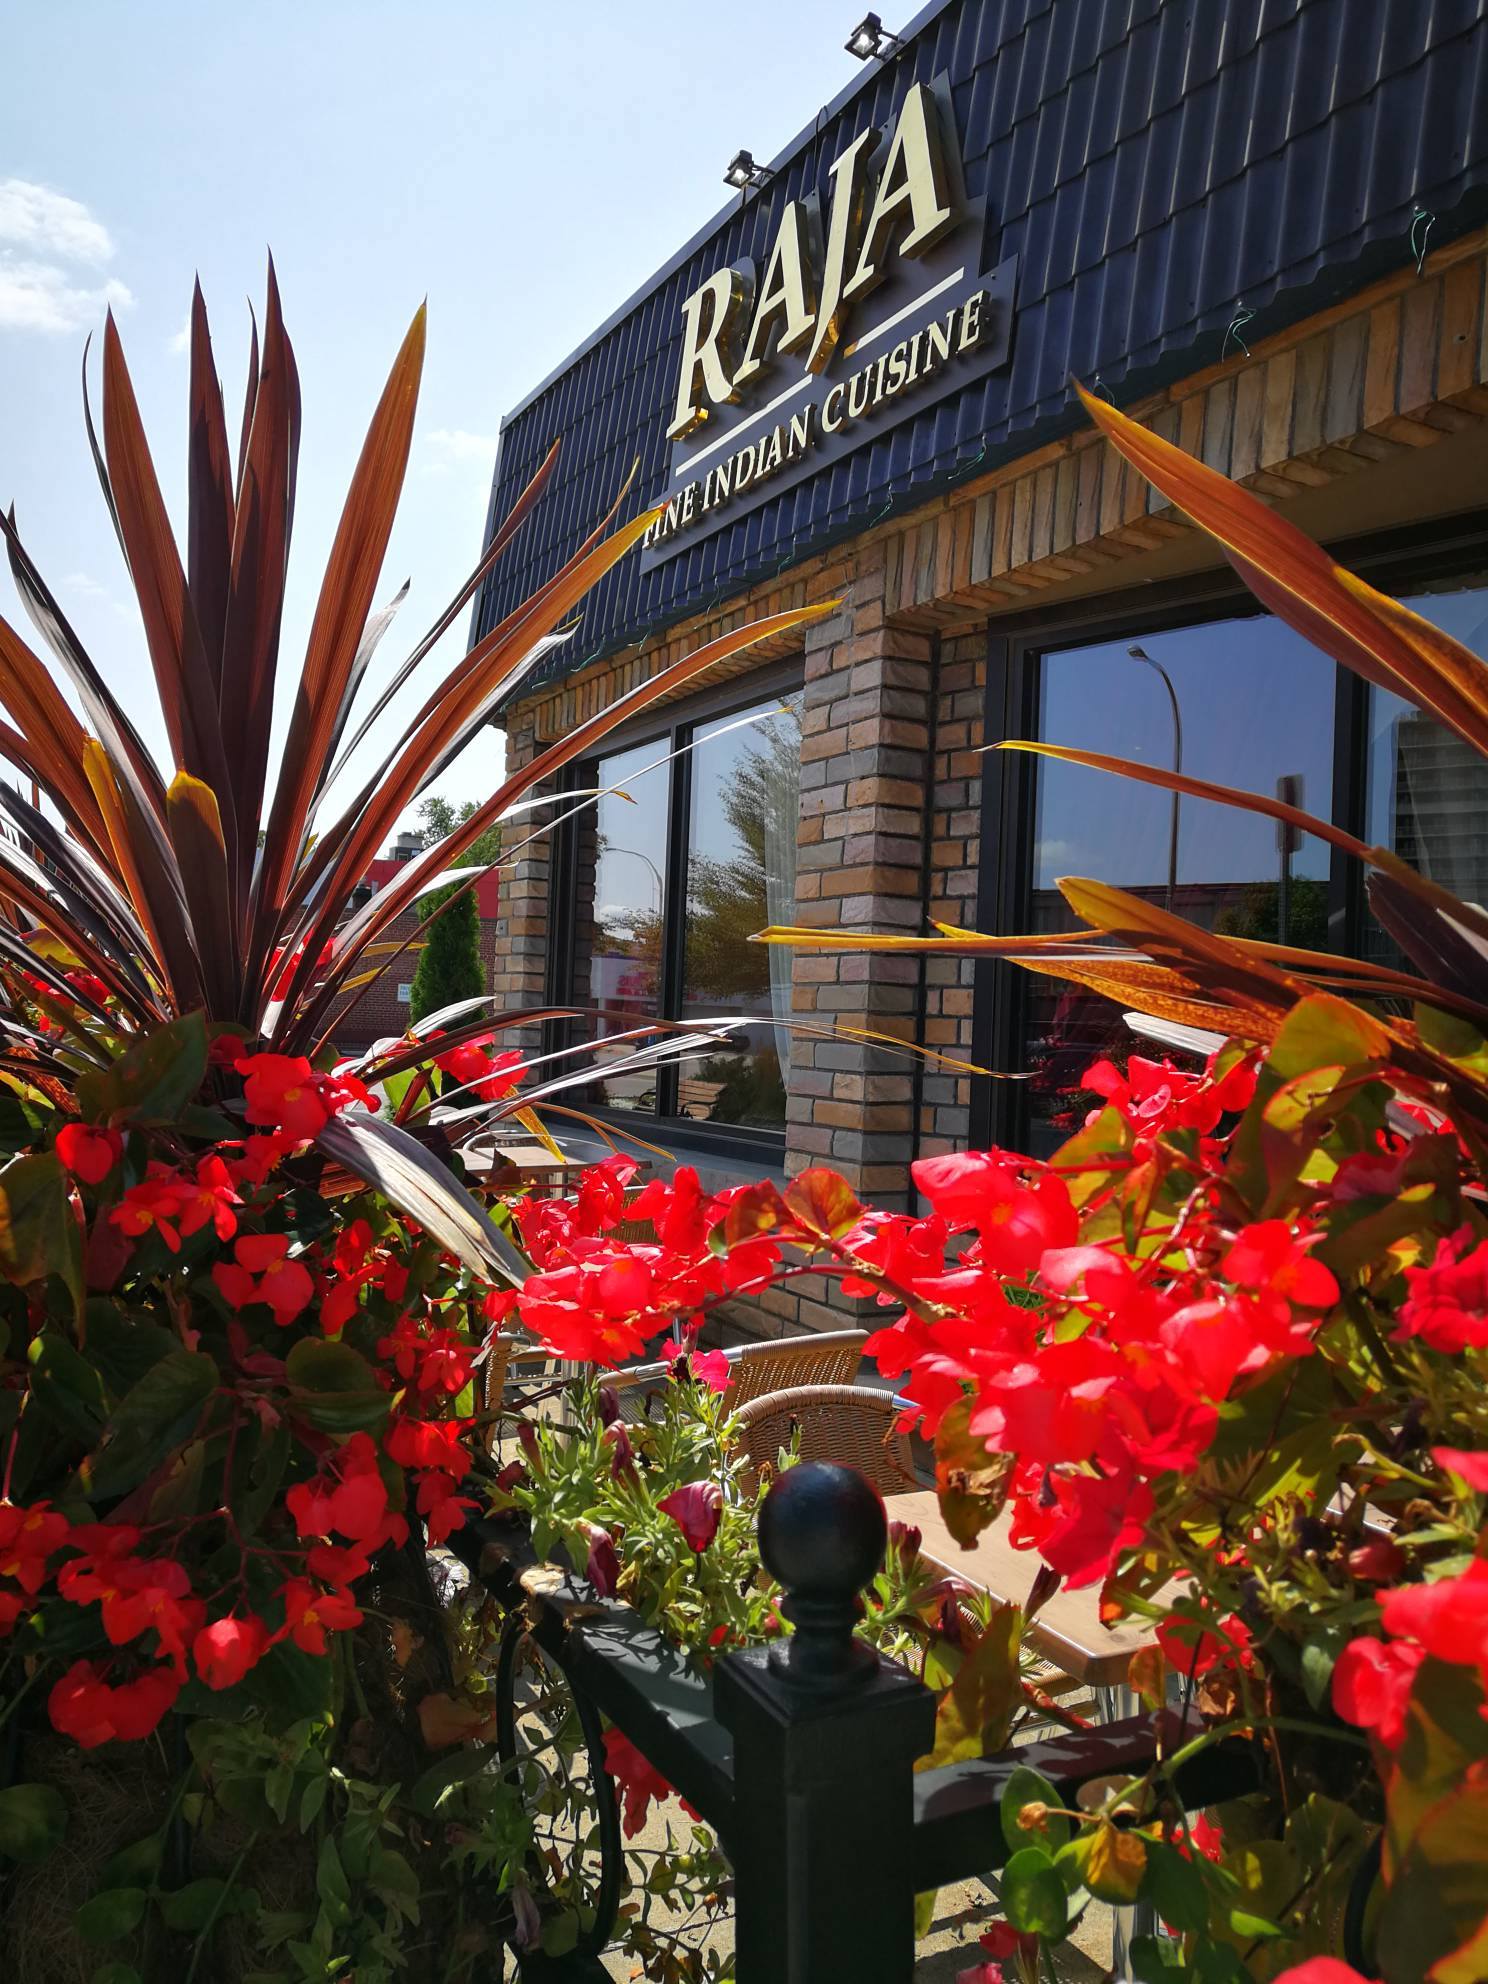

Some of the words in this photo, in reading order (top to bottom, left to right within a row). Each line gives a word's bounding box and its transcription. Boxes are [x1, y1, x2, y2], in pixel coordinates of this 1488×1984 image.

[666, 81, 950, 439] RAJA
[702, 404, 811, 512] INDIAN
[821, 290, 984, 433] CUISINE
